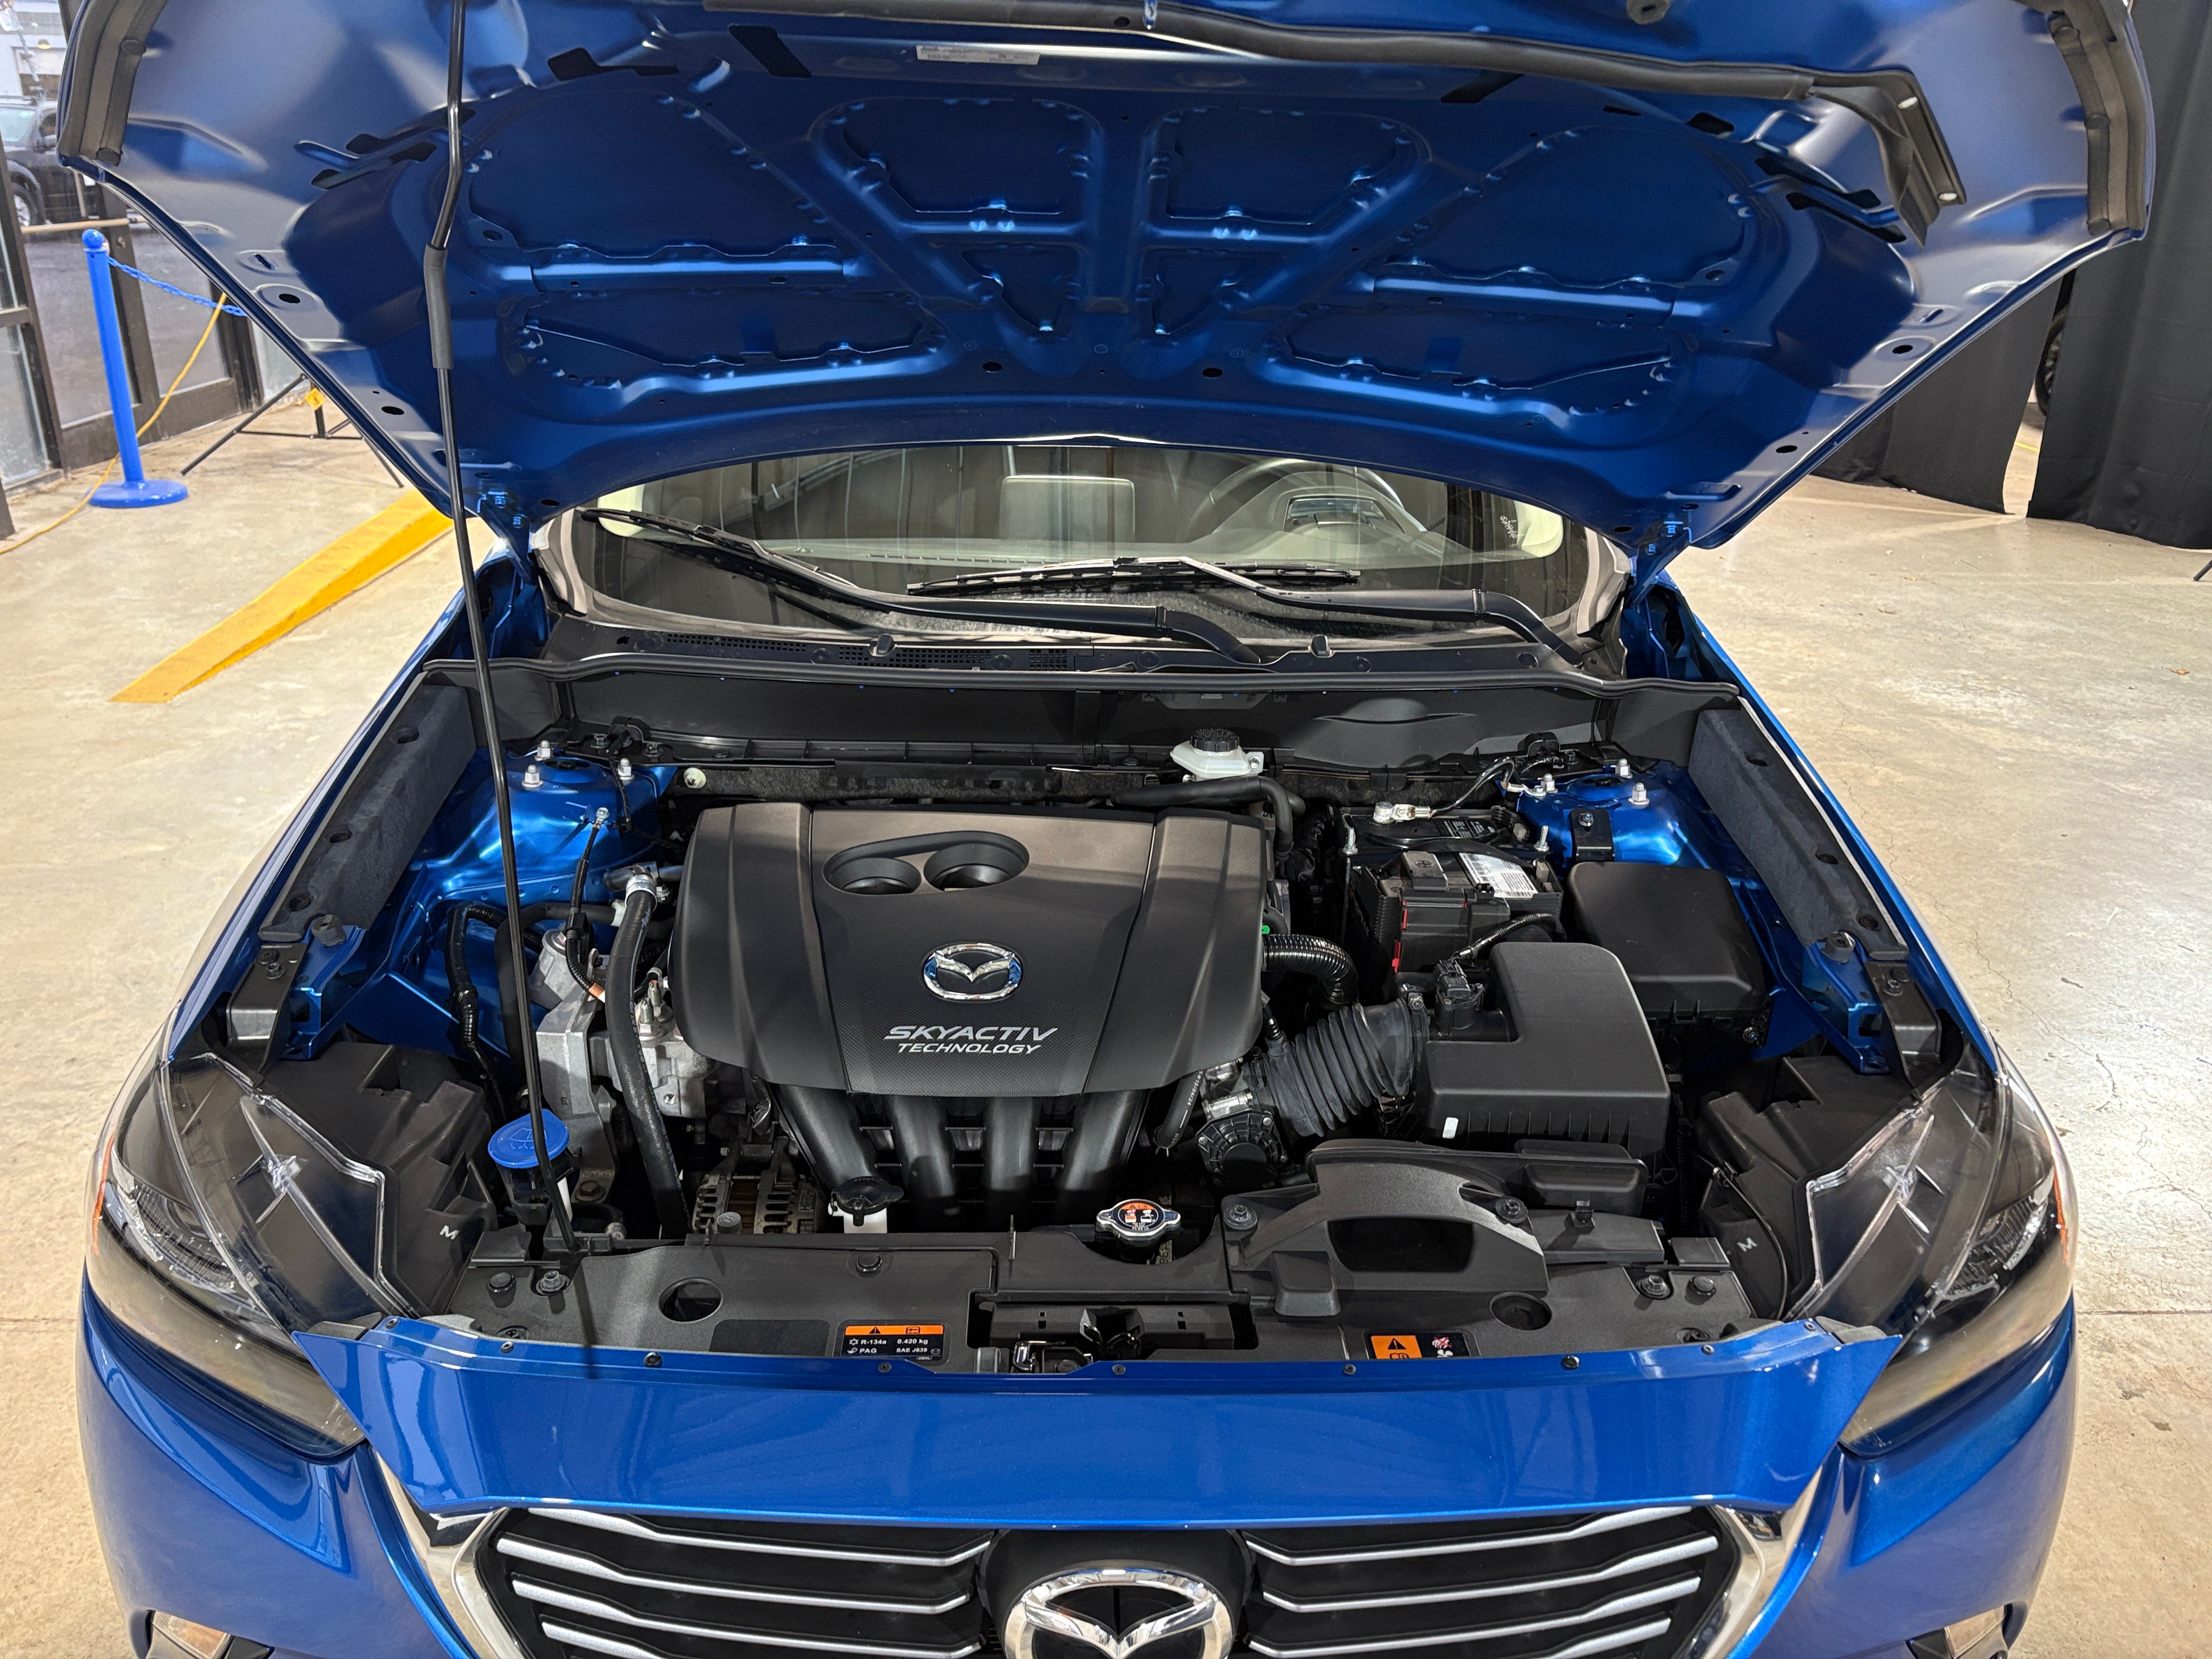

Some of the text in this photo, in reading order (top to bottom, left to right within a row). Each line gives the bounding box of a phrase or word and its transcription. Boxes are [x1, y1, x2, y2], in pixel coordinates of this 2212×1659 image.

[883, 1025, 1058, 1041] SKYACTIV
[898, 1043, 1041, 1055] TECHNOLOGY
[439, 1224, 460, 1240] M
[1736, 1237, 1758, 1252] M
